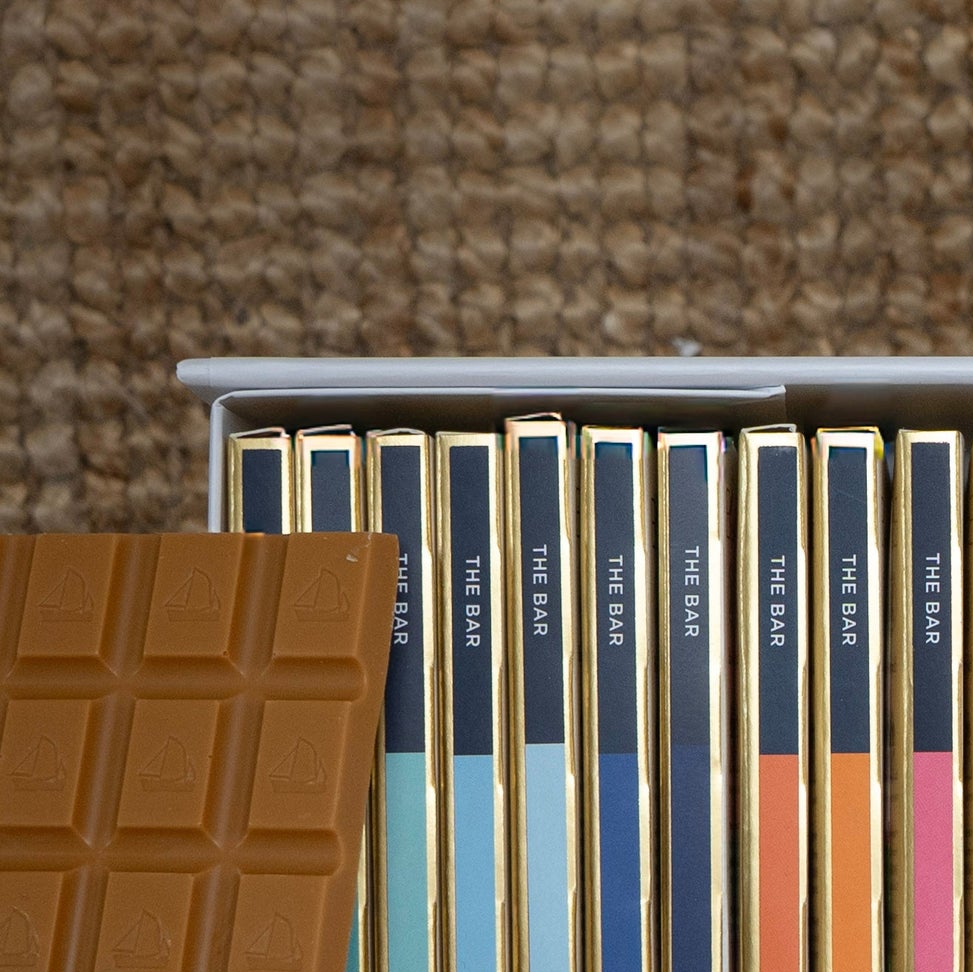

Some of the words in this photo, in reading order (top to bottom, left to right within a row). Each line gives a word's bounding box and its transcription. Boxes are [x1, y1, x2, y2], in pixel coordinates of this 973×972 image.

[398, 552, 409, 594] THE
[465, 555, 481, 596] THE
[532, 543, 548, 585] THE
[608, 554, 624, 595] THE
[684, 545, 700, 586] THE
[770, 554, 786, 596] THE
[841, 553, 857, 595] THE
[925, 552, 941, 593] THE
[393, 601, 409, 645] BAR
[465, 604, 481, 647] BAR
[533, 593, 548, 636] BAR
[608, 603, 624, 646] BAR
[684, 594, 700, 637] BAR
[770, 603, 785, 647] BAR
[841, 603, 857, 645] BAR
[925, 601, 940, 644] BAR
